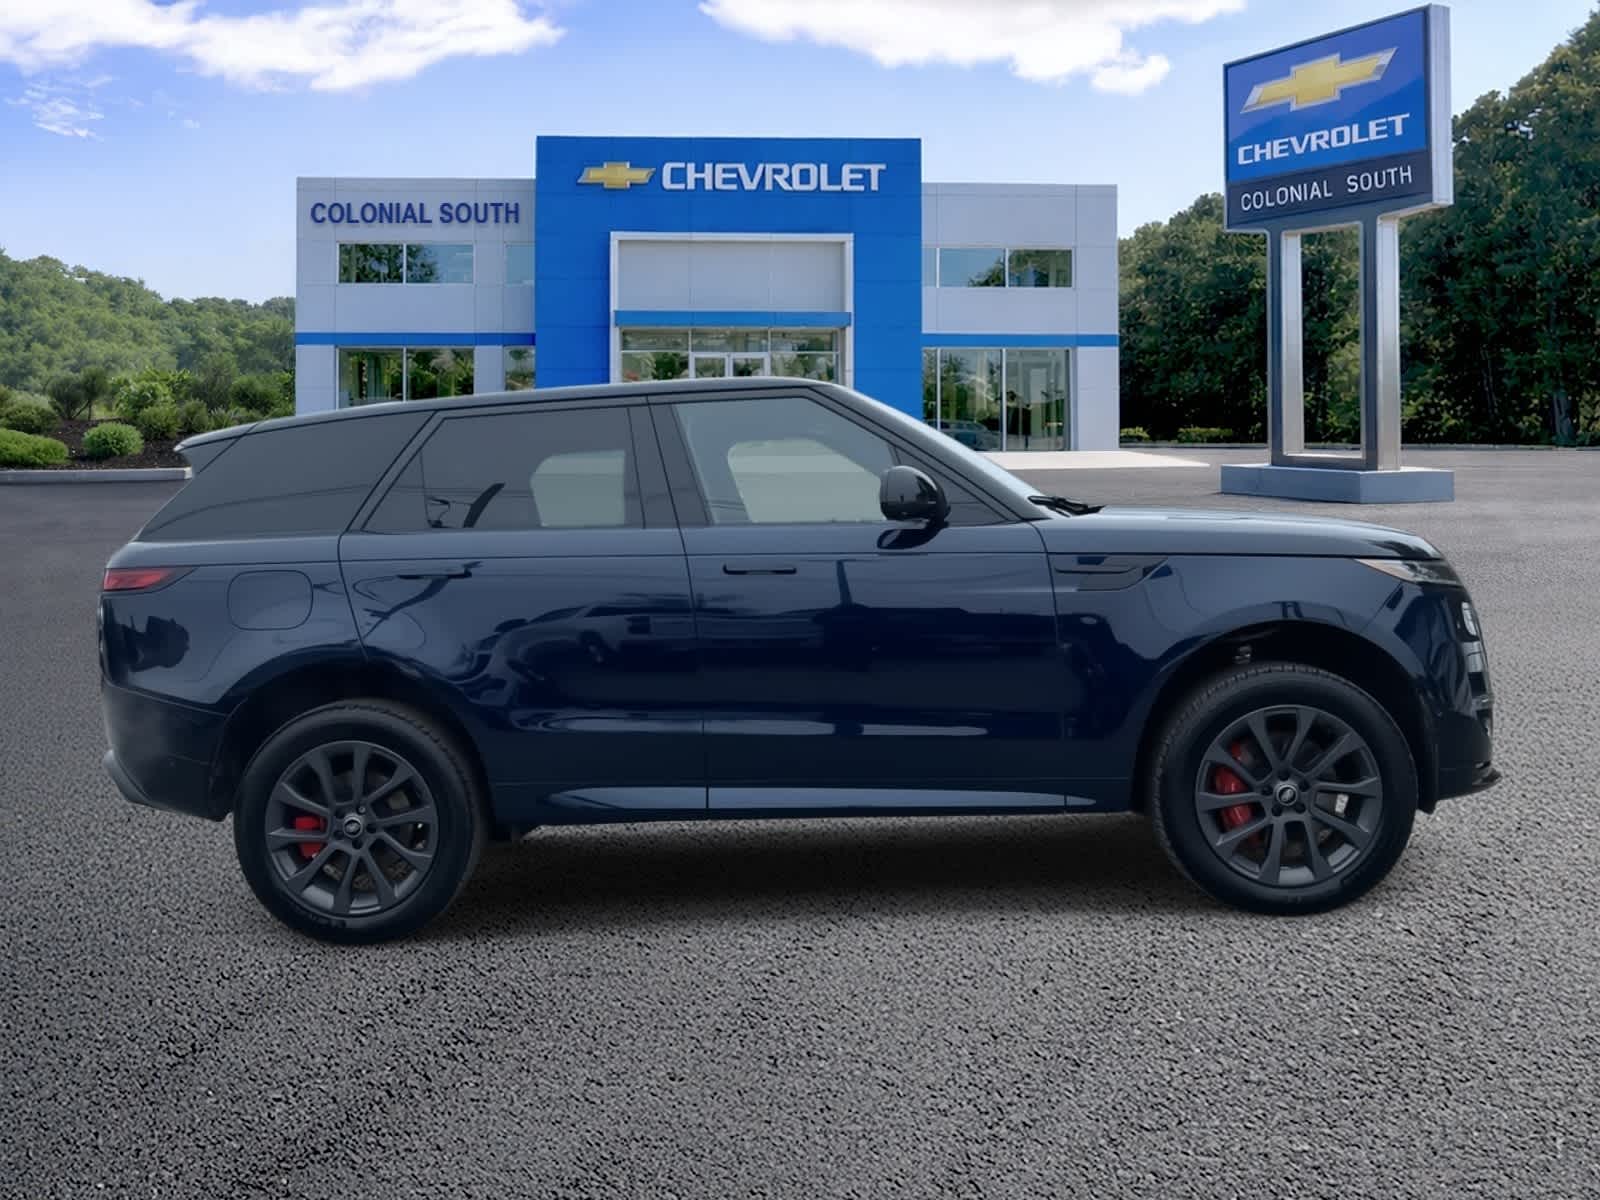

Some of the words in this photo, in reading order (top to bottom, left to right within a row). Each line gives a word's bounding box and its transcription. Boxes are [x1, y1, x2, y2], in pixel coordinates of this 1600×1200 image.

[1237, 112, 1410, 165] CHEVROLET
[661, 162, 887, 193] CHEVROLET
[1241, 180, 1333, 211] COLONIAL
[1346, 165, 1413, 193] SOUTH
[310, 202, 433, 225] COLONIAL
[439, 202, 520, 225] SOUTH
